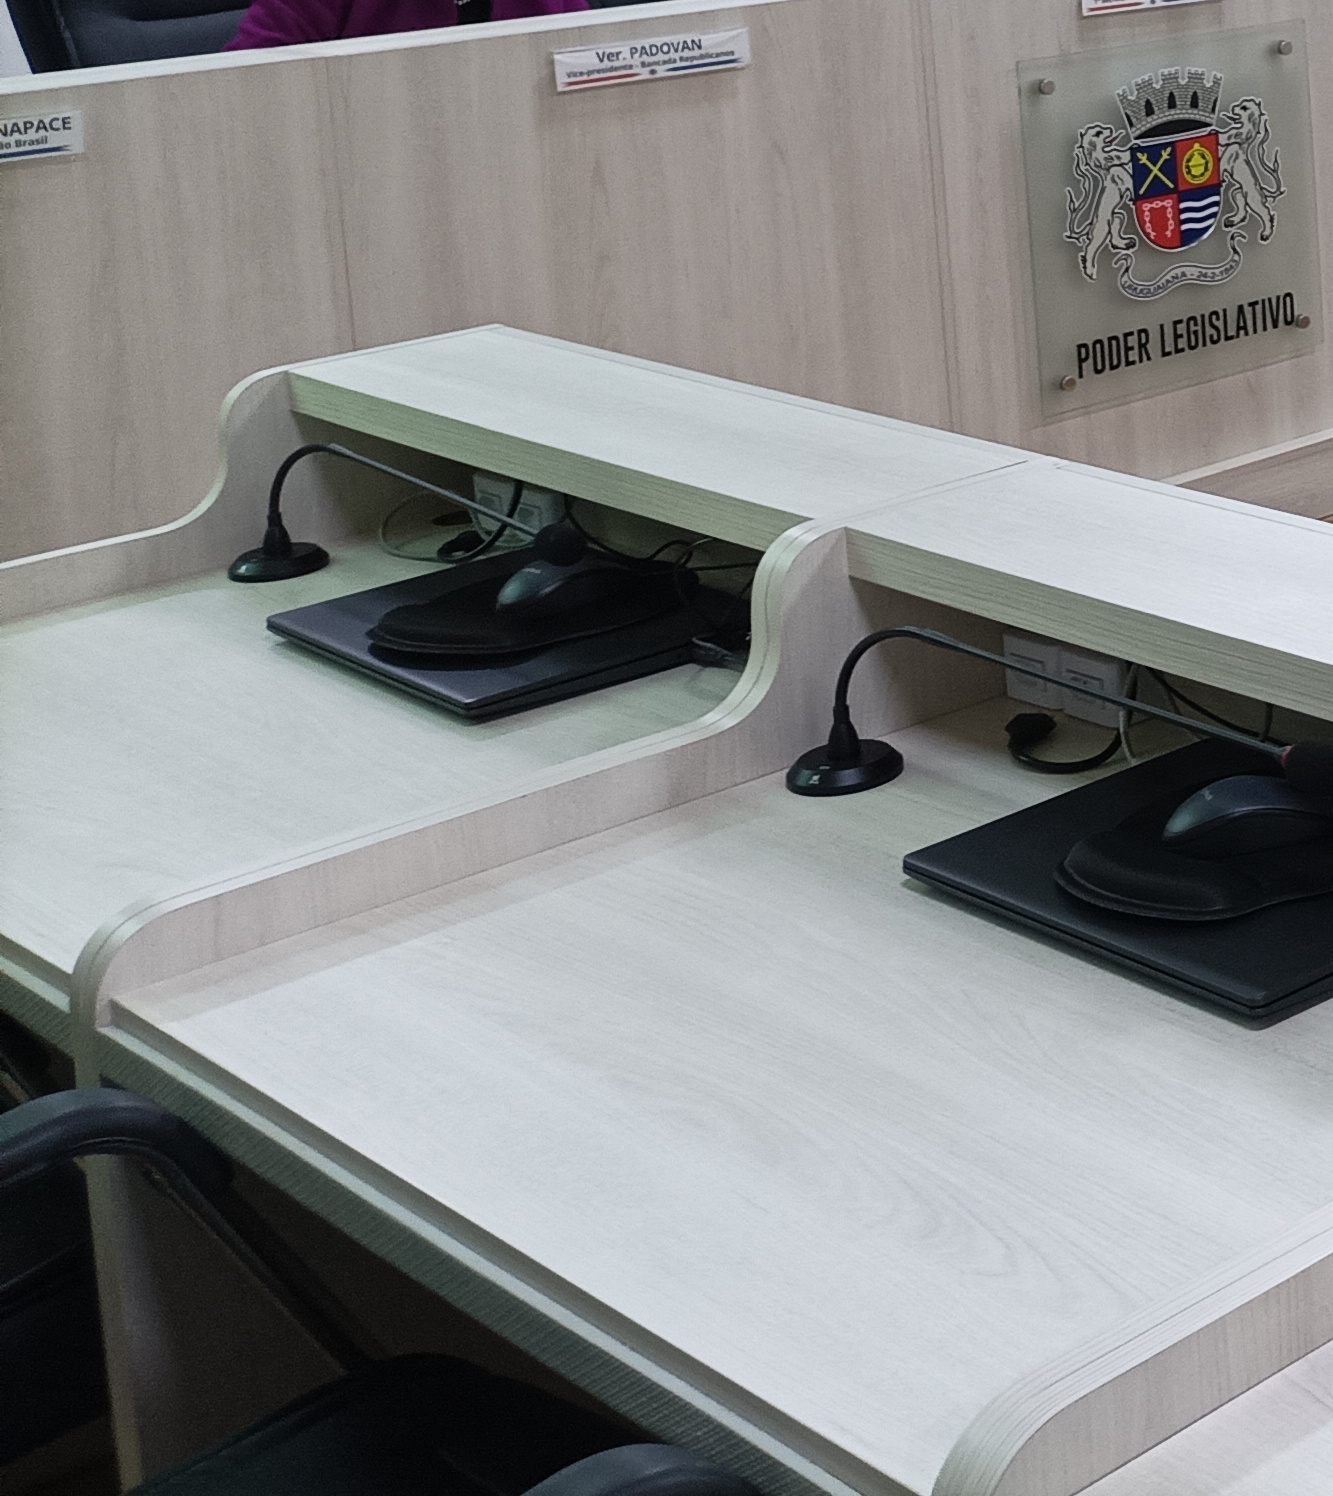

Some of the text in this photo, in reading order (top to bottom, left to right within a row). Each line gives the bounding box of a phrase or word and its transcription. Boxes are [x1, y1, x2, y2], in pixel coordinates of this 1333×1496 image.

[596, 38, 703, 64] Ver. PADOVAN
[641, 57, 677, 69] Bancada
[679, 50, 736, 63] Republicanos
[15, 135, 48, 148] Brasil
[1076, 292, 1297, 379] PODER LEGISLATIVO
